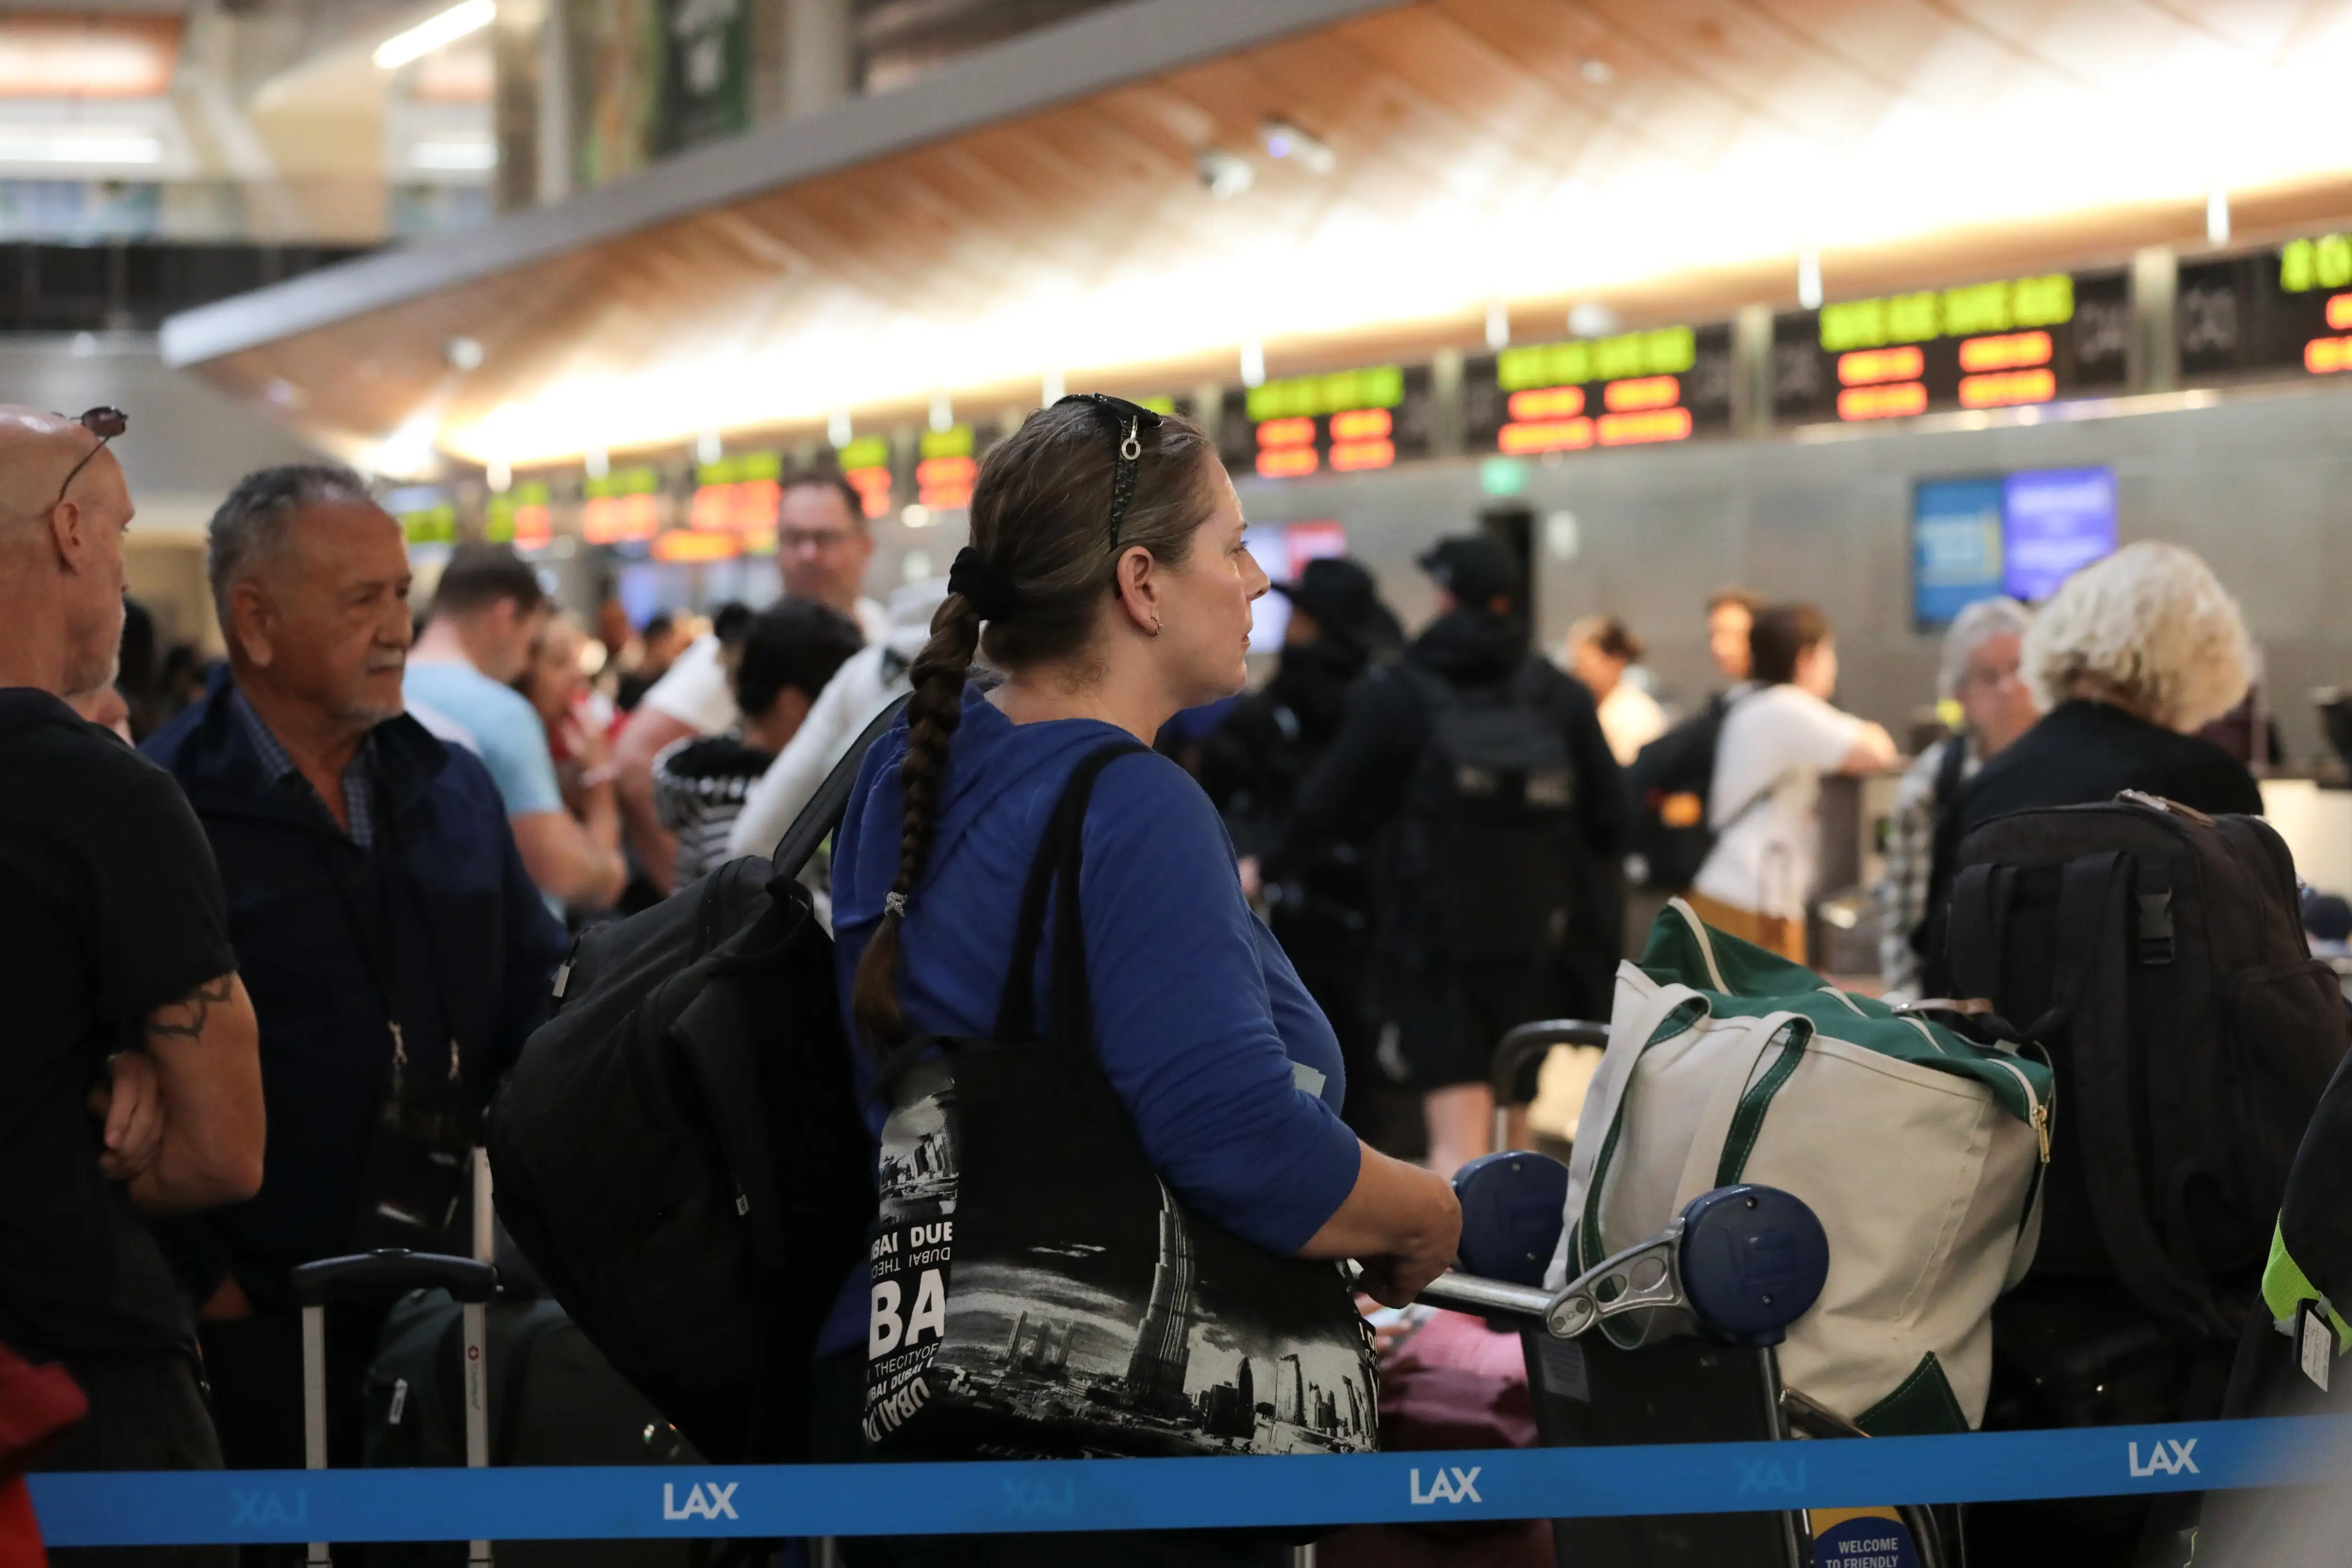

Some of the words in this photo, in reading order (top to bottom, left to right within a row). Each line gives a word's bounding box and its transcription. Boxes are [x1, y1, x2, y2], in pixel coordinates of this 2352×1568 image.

[871, 1232, 898, 1262] BAI
[909, 1247, 951, 1268] DUBAI
[869, 1268, 946, 1361] BA
[891, 1361, 924, 1390] DUBAI
[2128, 1438, 2200, 1477] LAX
[1410, 1466, 1483, 1504] LAX
[664, 1482, 739, 1520] LAX
[1838, 1537, 1898, 1554] WELCOME
[1826, 1560, 1840, 1568] TO
[1843, 1555, 1899, 1568] FRIENDLY
